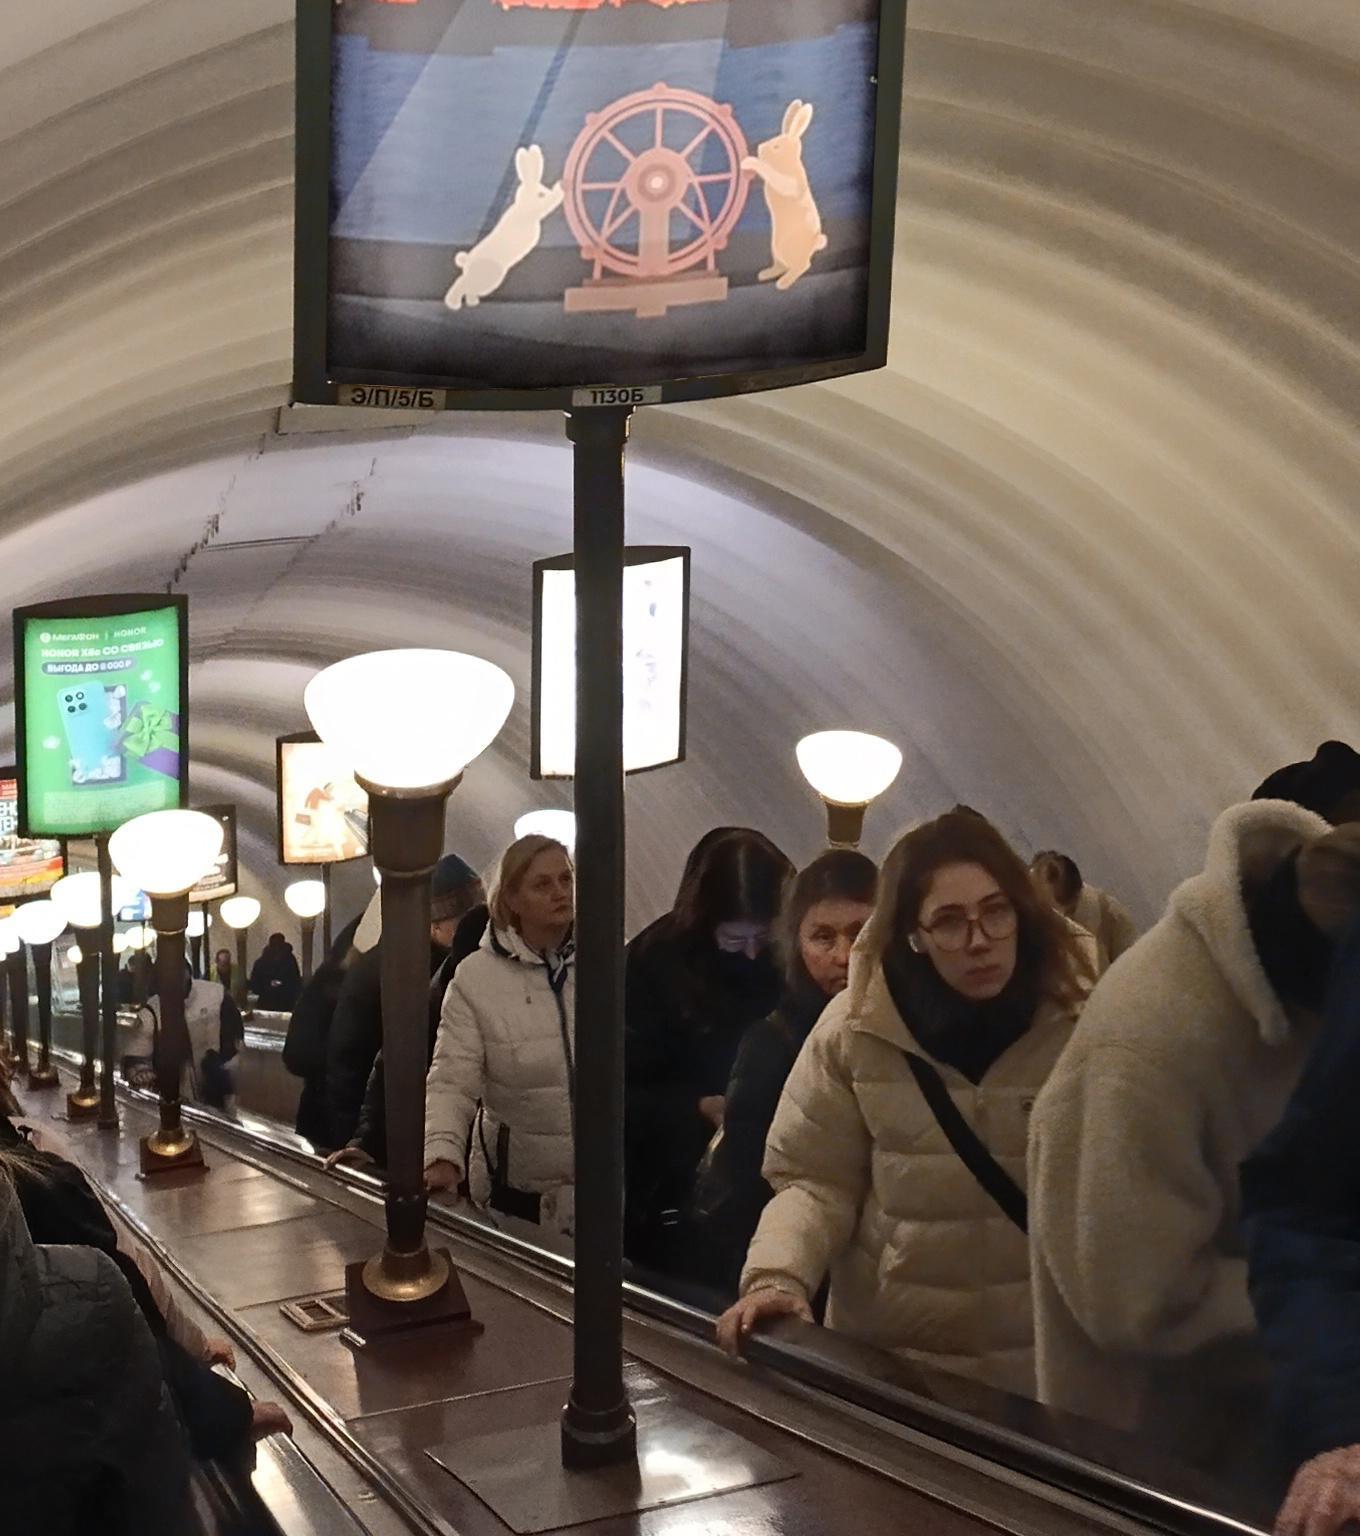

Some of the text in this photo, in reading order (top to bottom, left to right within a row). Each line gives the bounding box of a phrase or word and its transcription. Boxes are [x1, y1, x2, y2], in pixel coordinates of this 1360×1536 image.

[351, 386, 435, 408] Э/П/5/Б
[591, 388, 644, 404] 1130Б
[102, 644, 120, 656] СО
[47, 662, 84, 673] ВЫГОДА
[84, 662, 100, 673] ДО
